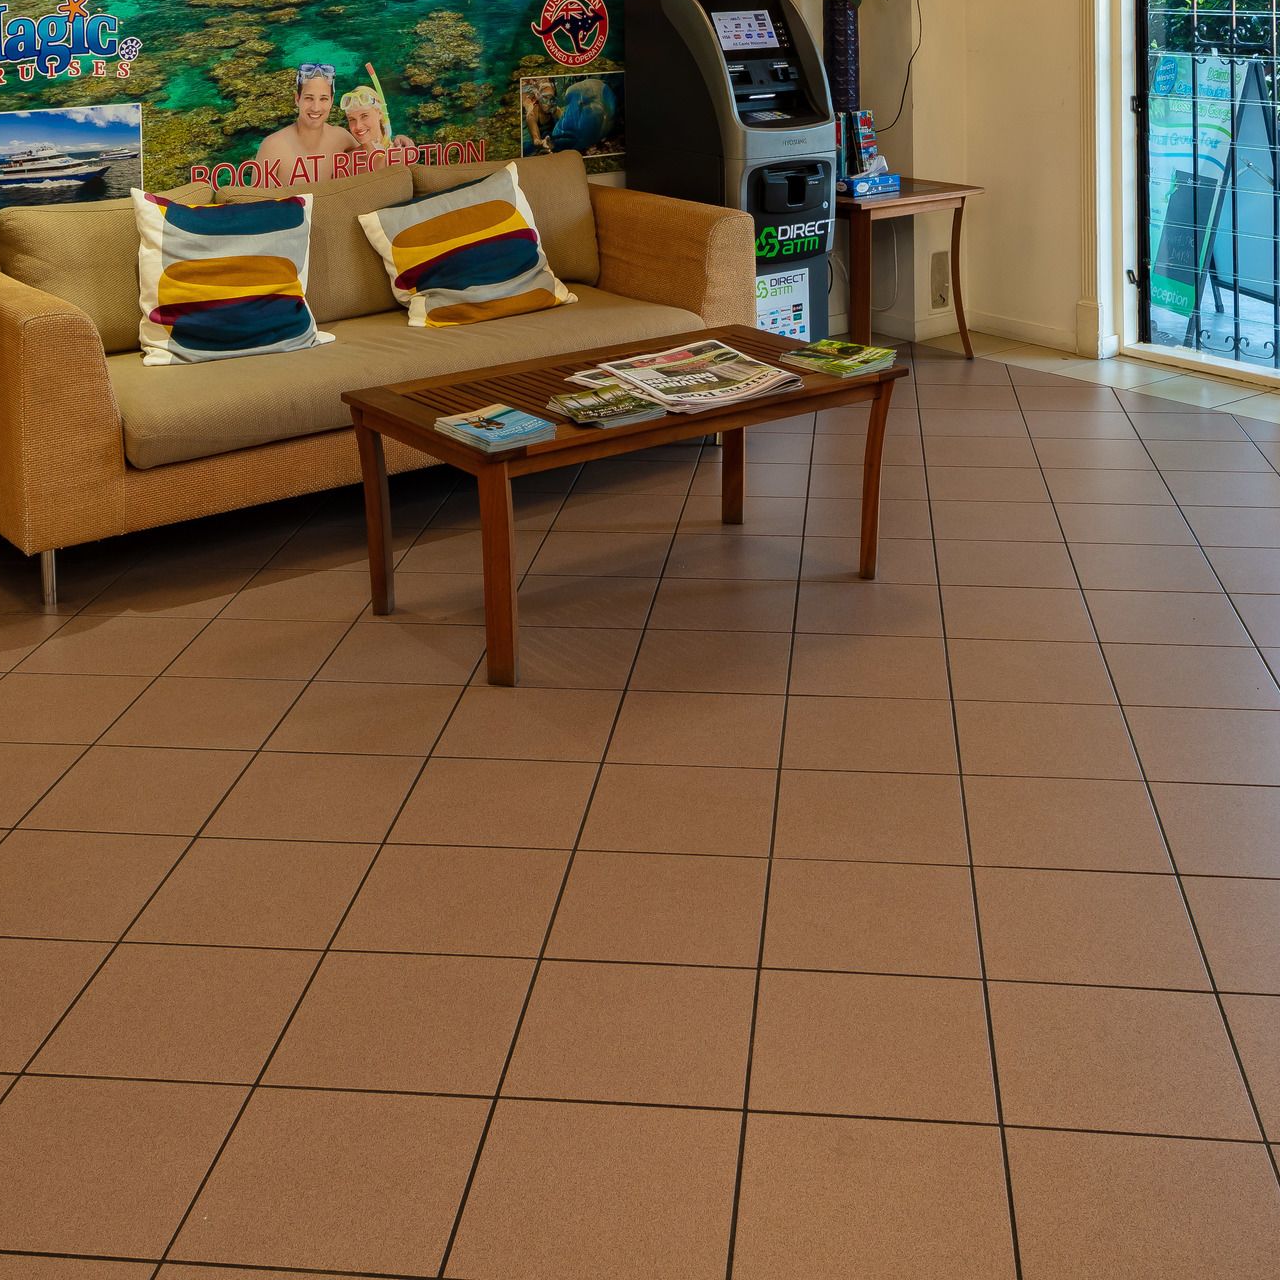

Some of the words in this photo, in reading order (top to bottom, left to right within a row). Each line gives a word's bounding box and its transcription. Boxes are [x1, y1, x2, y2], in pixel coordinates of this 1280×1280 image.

[546, 39, 568, 62] OWNED
[568, 56, 574, 64] &
[574, 34, 605, 63] OPERATED
[1150, 134, 1169, 146] mall
[1169, 133, 1193, 146] Grou
[190, 158, 283, 193] BOOK
[289, 154, 326, 186] AT
[332, 139, 486, 179] RECEPTION
[777, 218, 836, 240] DIRECT
[770, 273, 805, 288] DIRECT
[1151, 285, 1189, 307] eception
[649, 379, 706, 390] LIVING
[717, 369, 783, 395] Cairns
[672, 389, 719, 400] Post
